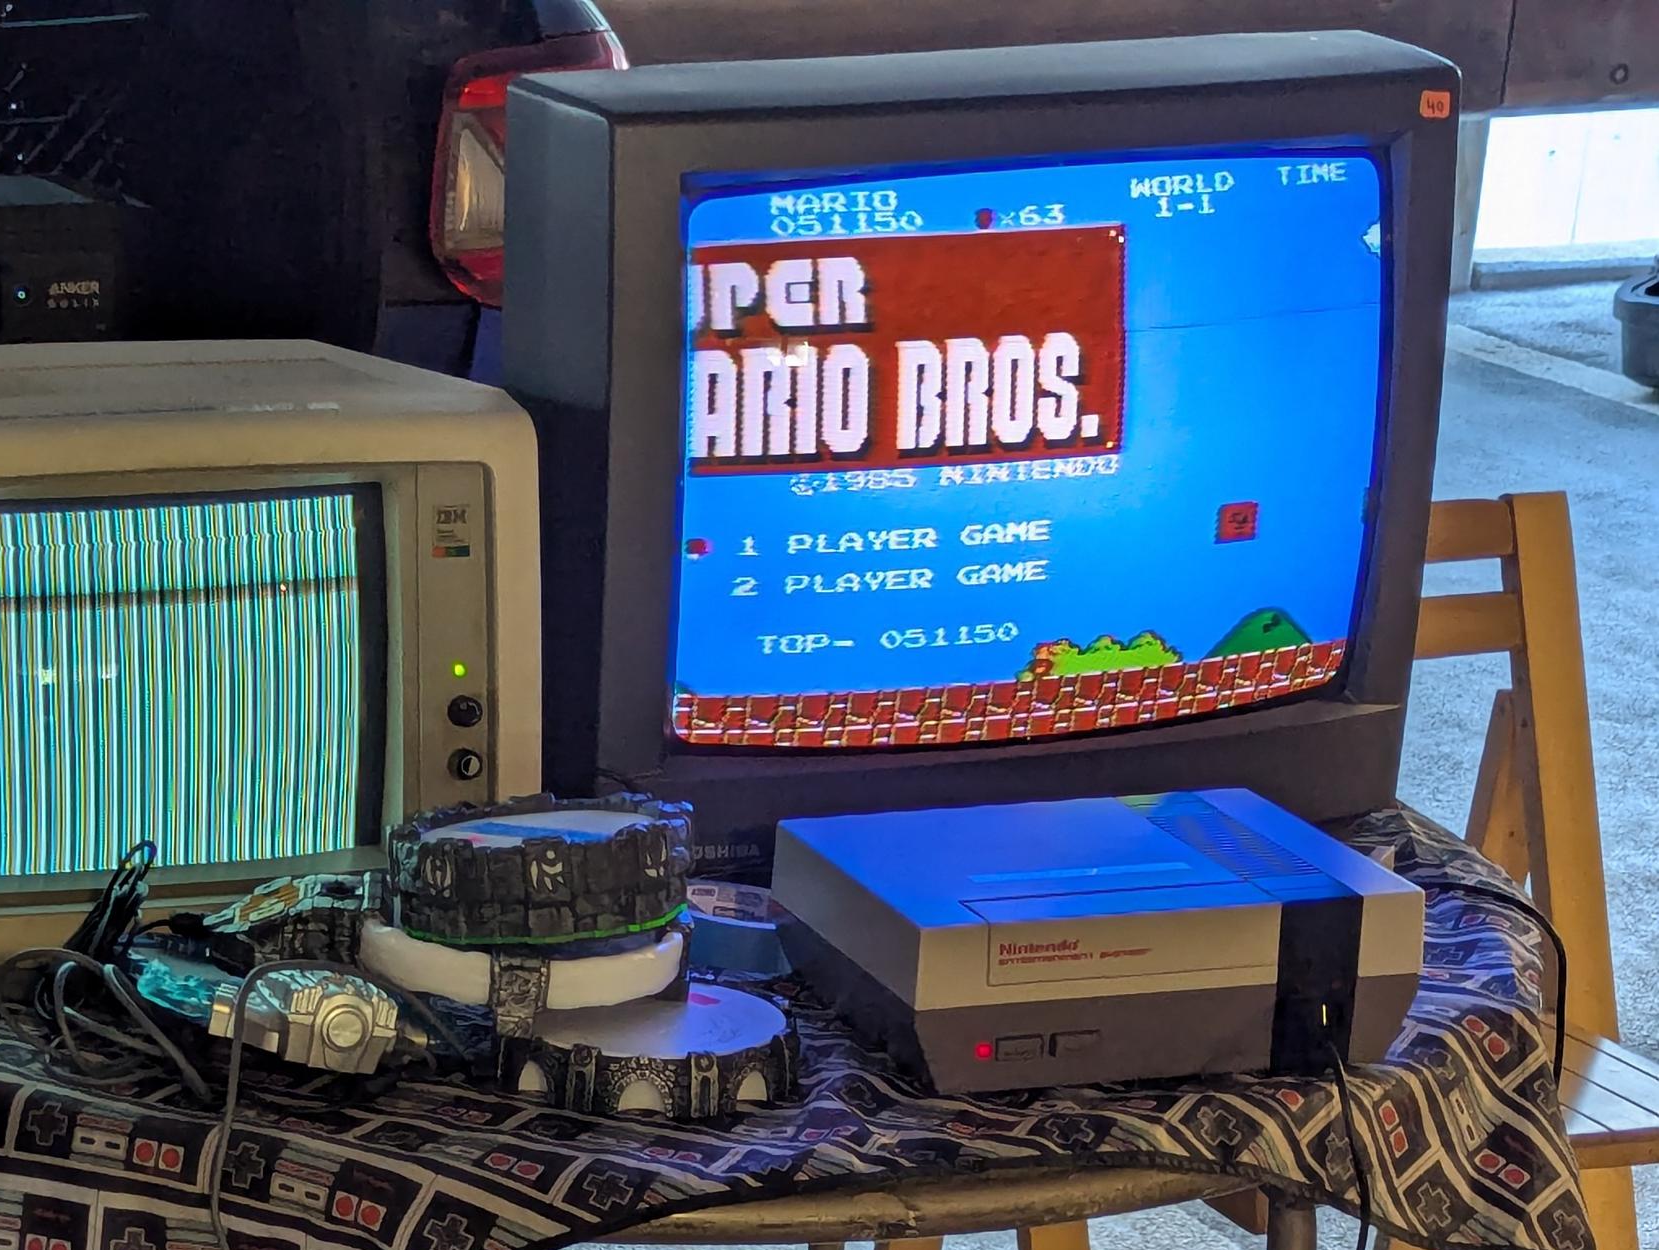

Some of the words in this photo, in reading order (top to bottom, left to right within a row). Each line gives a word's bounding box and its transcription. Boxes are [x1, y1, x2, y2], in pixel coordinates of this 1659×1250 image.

[1130, 171, 1235, 198] WORLD
[1277, 162, 1348, 186] TIME
[771, 190, 898, 214] MARIO
[1155, 194, 1215, 218] 1-1
[771, 210, 923, 238] 051150
[49, 280, 100, 296] ANKER
[692, 344, 871, 458] ARIO
[895, 332, 1100, 451] BROS.
[940, 455, 1120, 487] NINTENDO
[436, 509, 467, 525] IBM
[740, 536, 760, 556] 1
[787, 527, 939, 556] PLAYER
[960, 519, 1053, 547] GAME
[730, 577, 759, 597] 2
[784, 567, 933, 595] PLAYER
[956, 559, 1050, 586] GAME
[880, 621, 1020, 649] 051150
[691, 843, 761, 860] OSHIBA
[999, 940, 1080, 957] Nintendo
